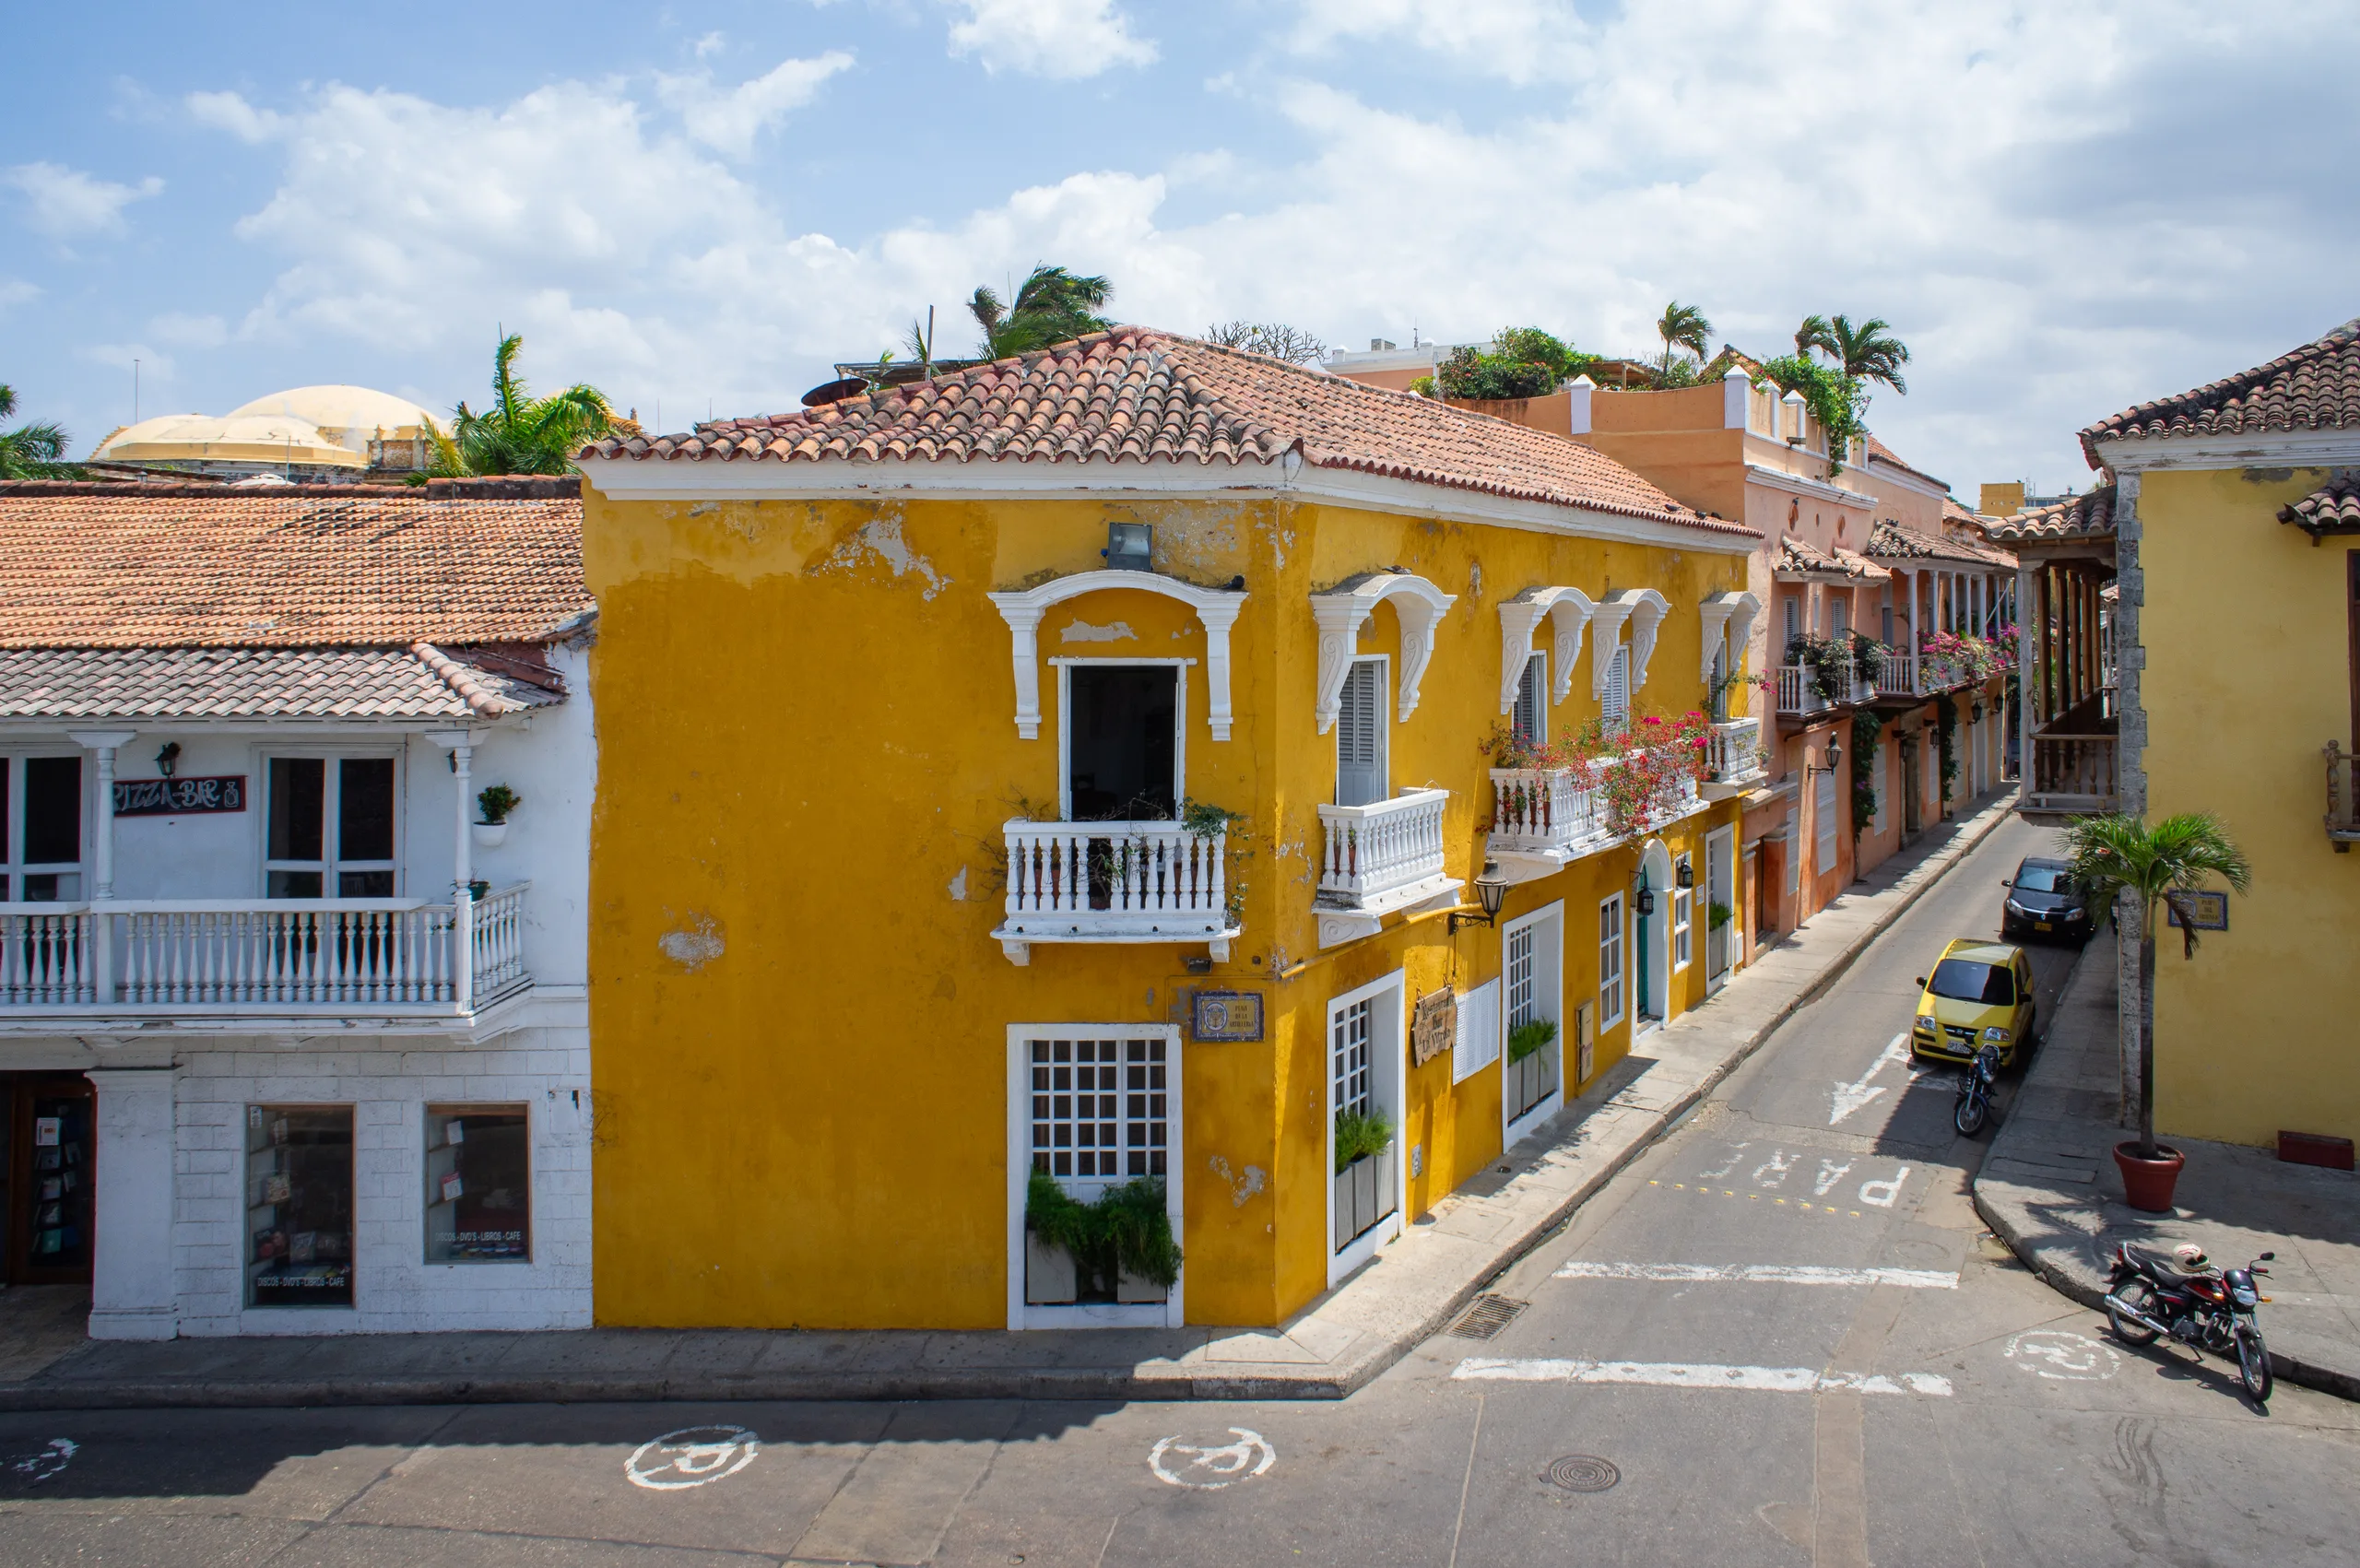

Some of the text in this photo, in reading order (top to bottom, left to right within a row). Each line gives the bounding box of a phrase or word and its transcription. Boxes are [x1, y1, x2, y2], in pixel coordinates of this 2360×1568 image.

[1698, 1141, 1911, 1208] PARE
[435, 1231, 522, 1242] DISCOS DVD'S LIBROS CAFE
[257, 1276, 279, 1287] DISCOS
[303, 1276, 325, 1287] LIBROS
[329, 1276, 345, 1287] CAFE
